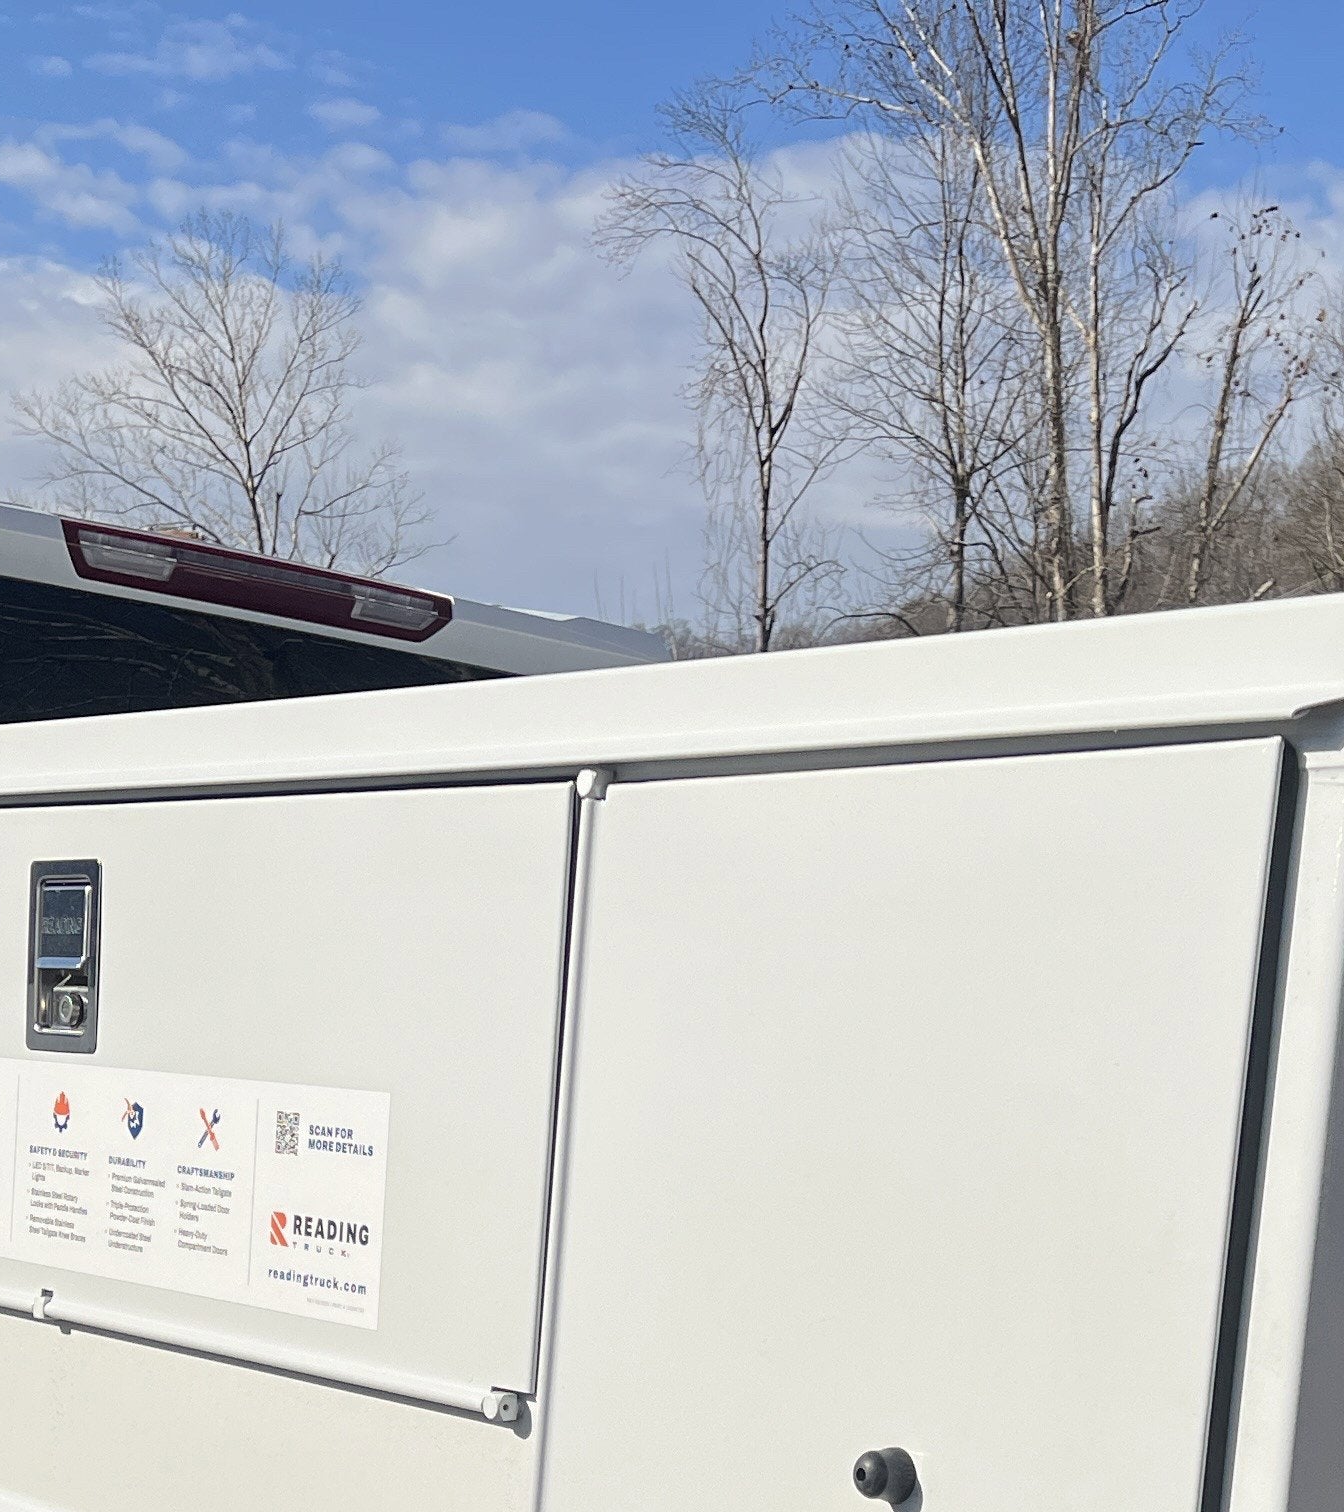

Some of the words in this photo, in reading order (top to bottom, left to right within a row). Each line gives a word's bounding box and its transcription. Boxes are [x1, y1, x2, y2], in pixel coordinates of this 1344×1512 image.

[308, 1125, 333, 1138] SCAN
[335, 1127, 354, 1140] FOR
[29, 1145, 52, 1156] SAFETY
[58, 1149, 88, 1160] SECURITY
[308, 1138, 334, 1153] MORE
[335, 1141, 374, 1157] DETAILS
[108, 1155, 146, 1169] DURABILITY
[177, 1165, 235, 1181] CRAFTSMANSHIP
[293, 1214, 369, 1246] READING
[268, 1268, 367, 1296] readingtruck.com
